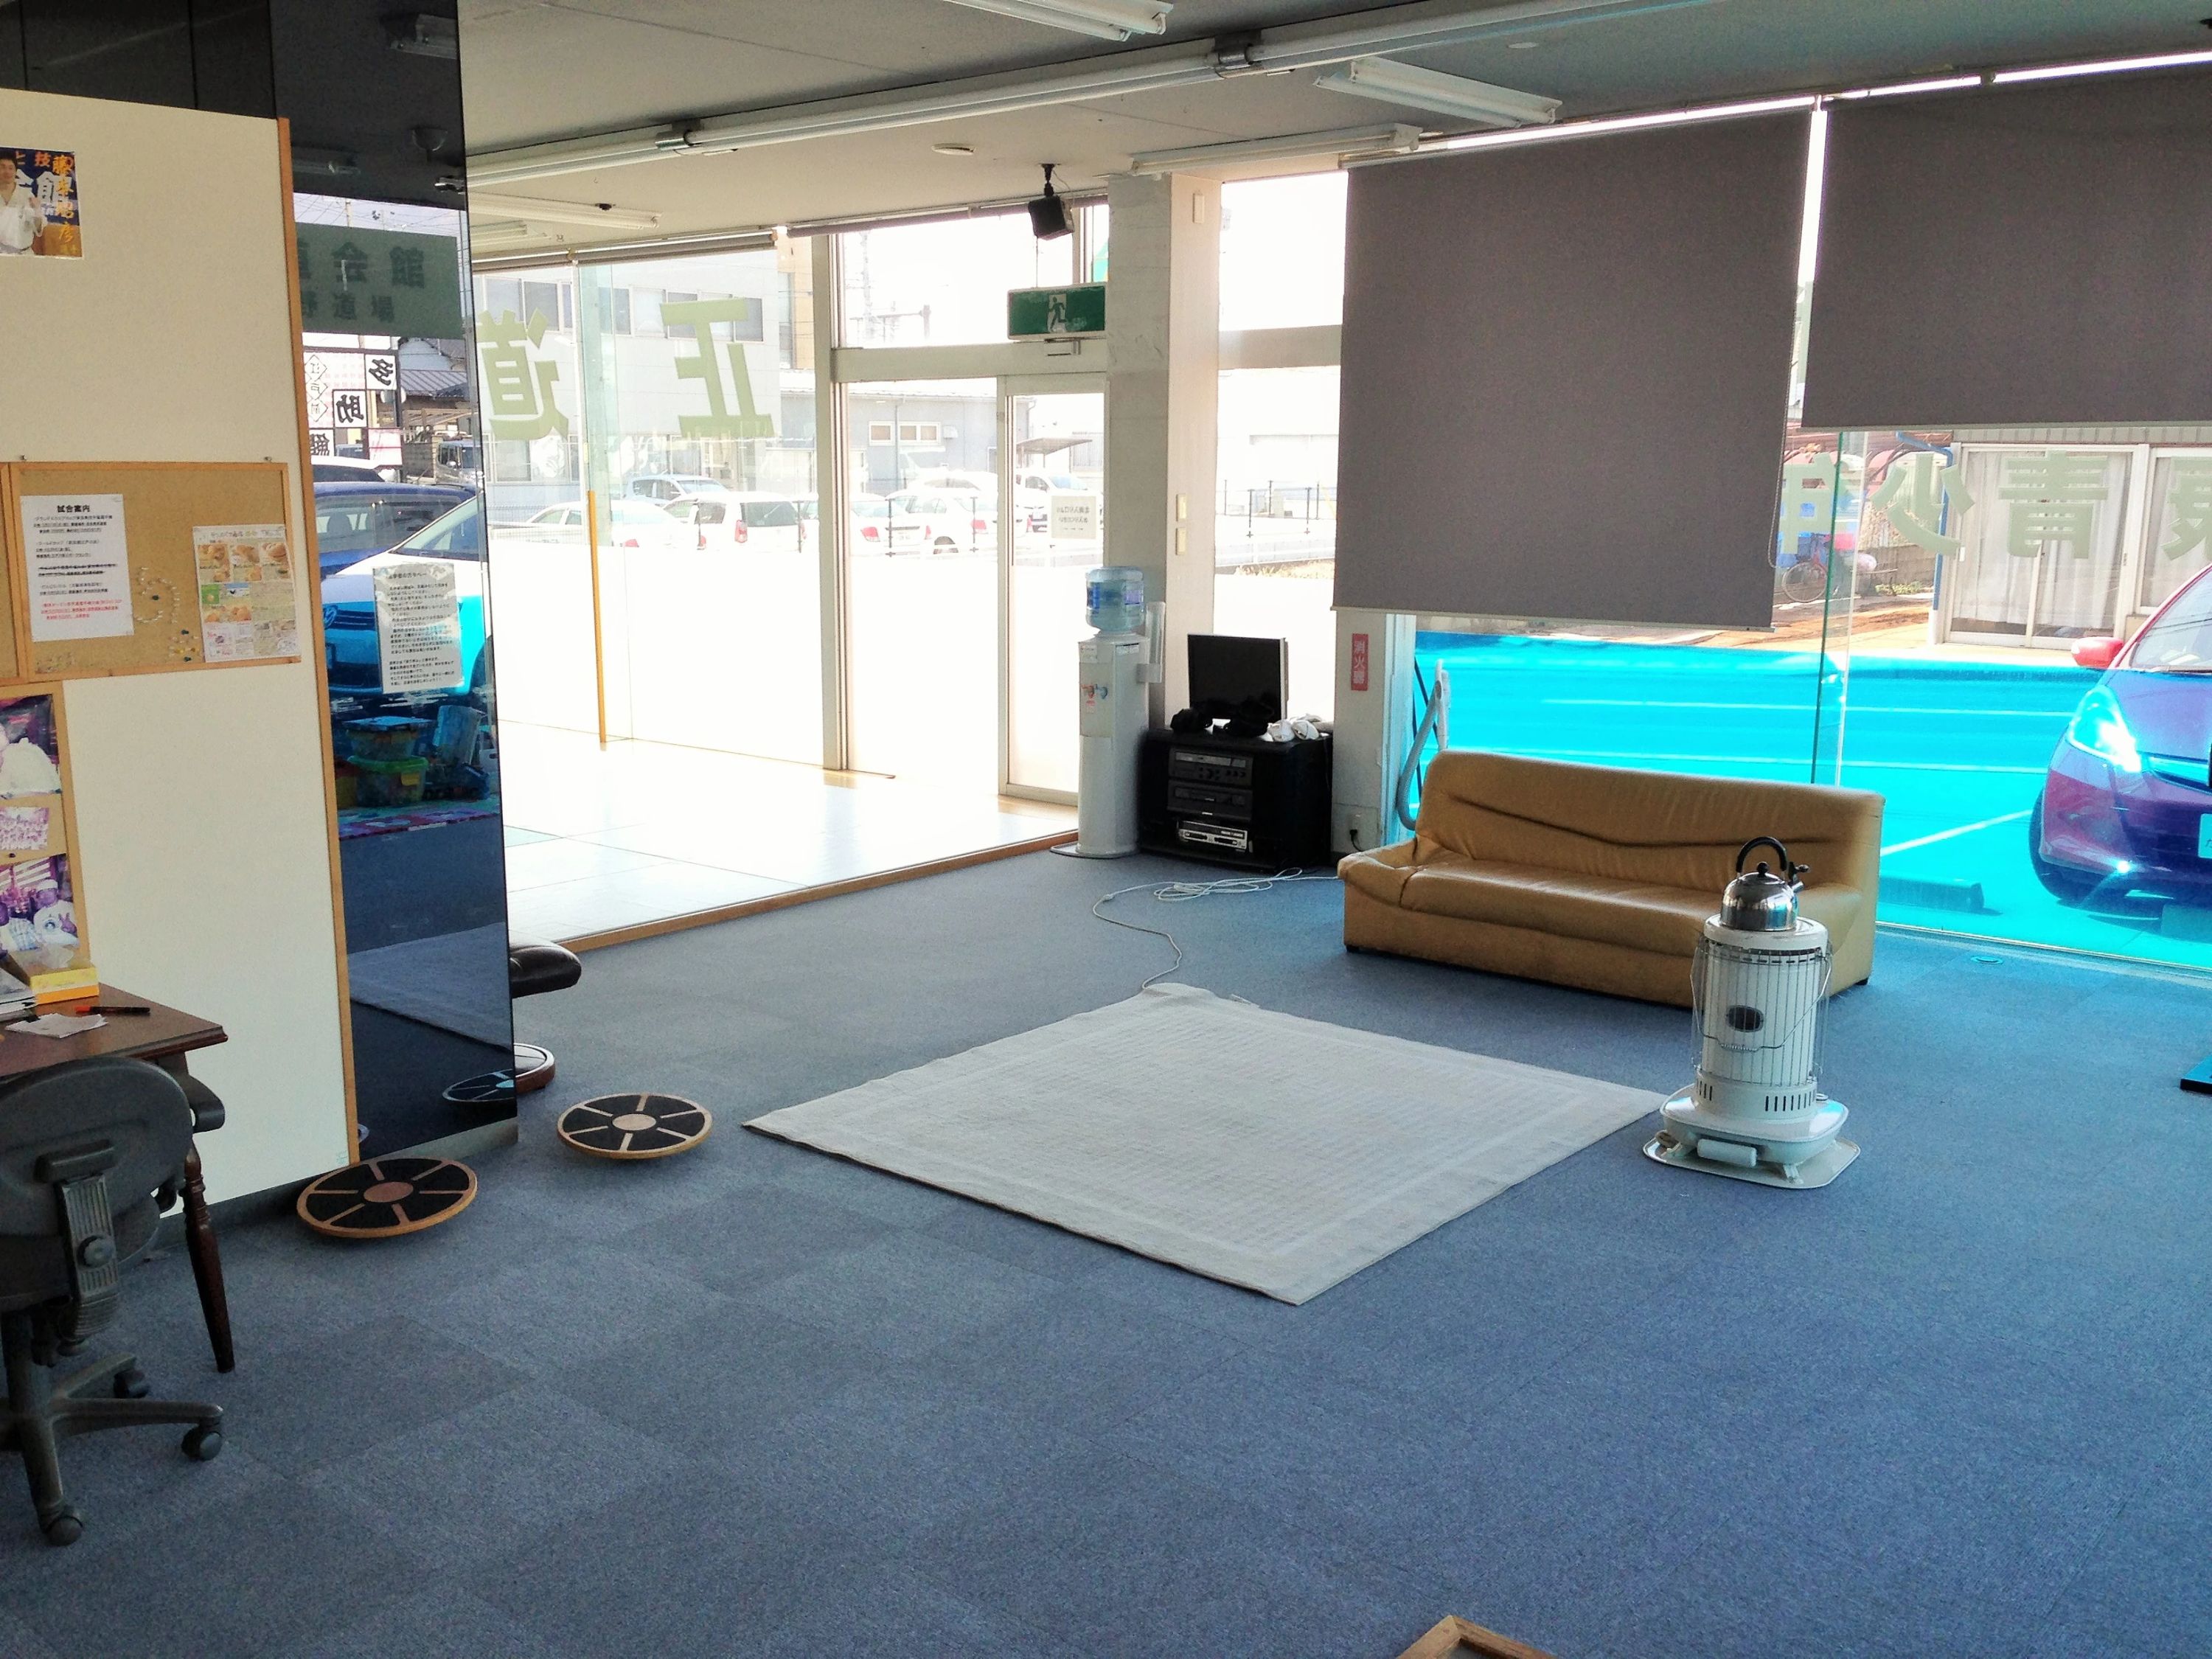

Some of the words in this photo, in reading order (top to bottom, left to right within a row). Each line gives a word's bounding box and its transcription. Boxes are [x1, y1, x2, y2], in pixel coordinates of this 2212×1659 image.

[57, 504, 91, 513] 試合案内
[1354, 640, 1365, 684] 消火器
